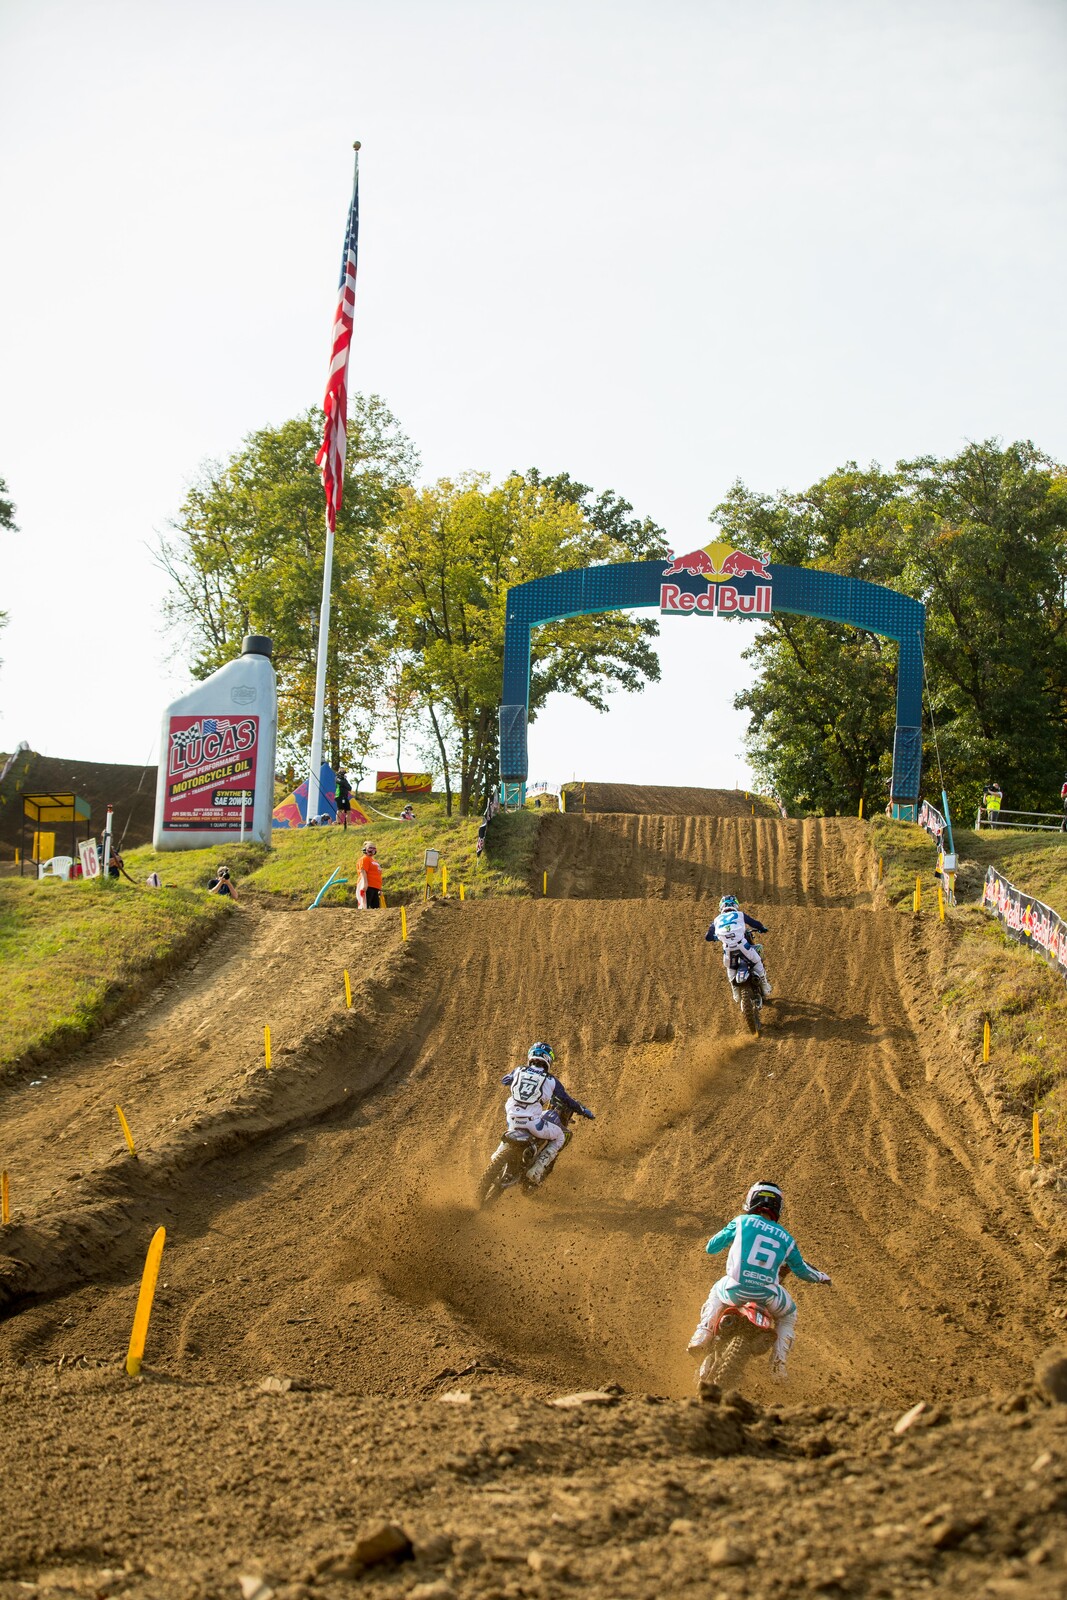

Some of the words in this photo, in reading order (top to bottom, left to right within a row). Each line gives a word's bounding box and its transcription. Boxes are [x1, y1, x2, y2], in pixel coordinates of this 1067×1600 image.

[660, 583, 716, 612] Red
[718, 585, 772, 614] Bull
[169, 720, 256, 776] LUCAS
[172, 765, 234, 795] MOTORCYCLE
[234, 760, 250, 773] OIL
[182, 769, 197, 779] HIGH
[197, 754, 240, 775] PERFORMANCE
[170, 793, 187, 803] ENGINE
[191, 779, 225, 795] TRANSMISSION
[229, 771, 251, 782] PRIMARY
[214, 797, 228, 806] SAE
[83, 846, 97, 877] 16
[521, 1083, 534, 1094] 14
[745, 1217, 790, 1243] MARTIN
[747, 1234, 780, 1270] 6
[742, 1270, 774, 1284] GEICO
